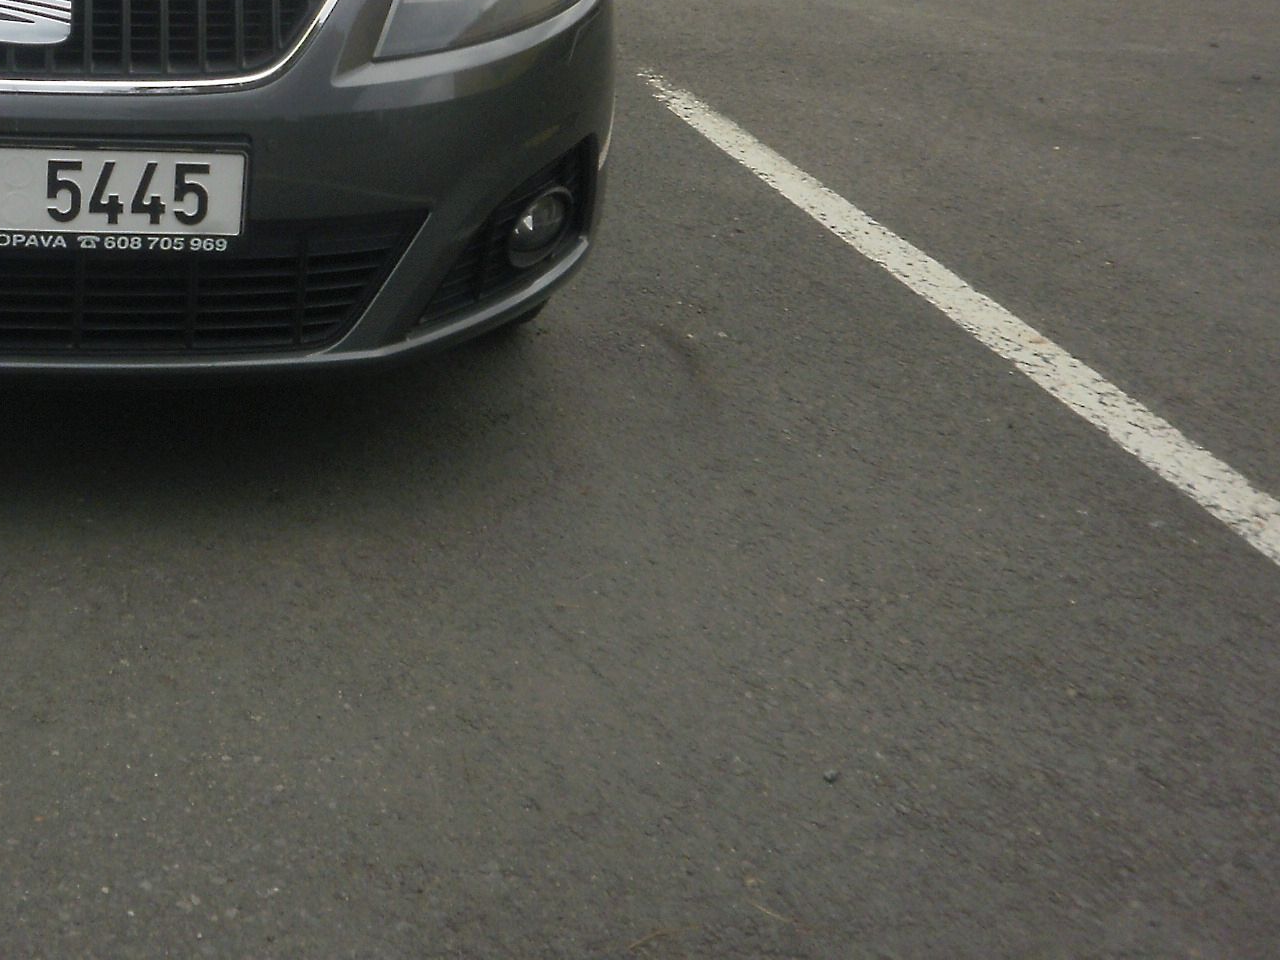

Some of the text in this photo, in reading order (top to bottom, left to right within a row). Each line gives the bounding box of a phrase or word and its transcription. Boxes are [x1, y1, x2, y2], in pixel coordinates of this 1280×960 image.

[46, 158, 210, 225] 5445
[103, 236, 142, 250] 608
[147, 237, 185, 250] 705
[189, 238, 228, 252] 969
